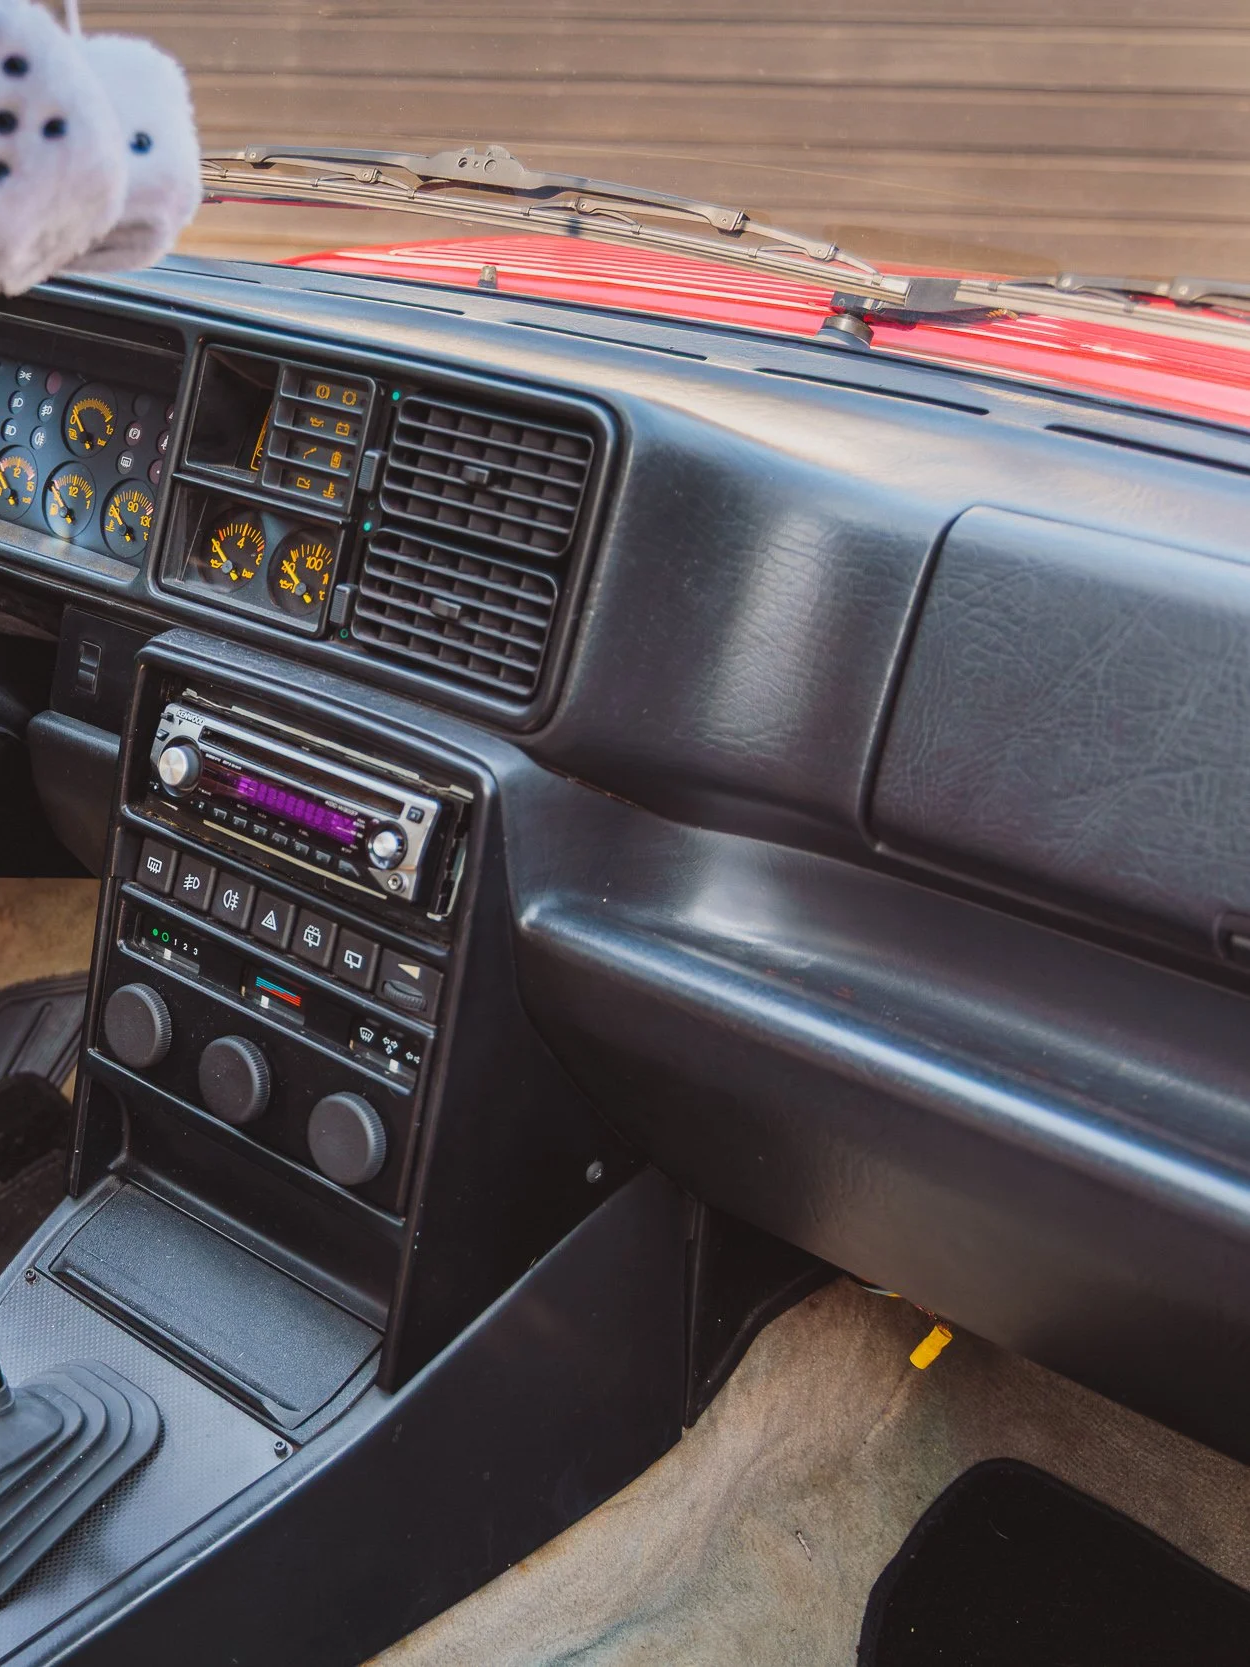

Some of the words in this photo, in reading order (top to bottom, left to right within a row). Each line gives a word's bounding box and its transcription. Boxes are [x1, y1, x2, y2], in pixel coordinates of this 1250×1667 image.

[127, 501, 139, 513] 90
[237, 537, 246, 549] 4
[305, 556, 324, 572] 100
[242, 568, 254, 579] bar
[176, 709, 205, 726] KENWOOD
[174, 938, 178, 946] 1
[182, 943, 188, 951] 2
[193, 948, 199, 956] 3
